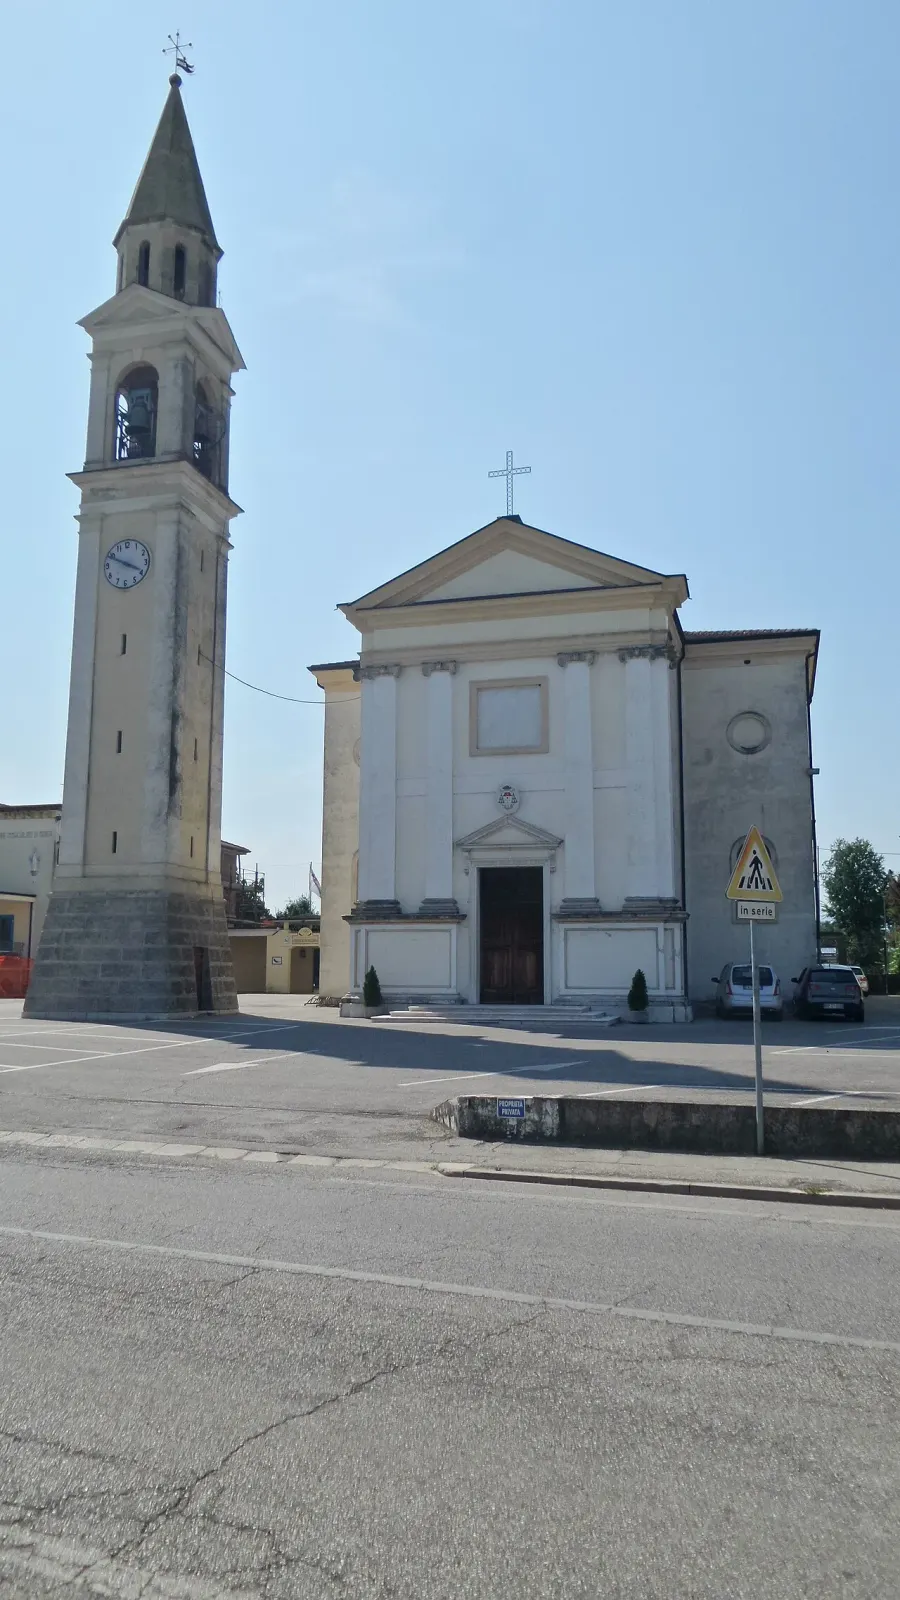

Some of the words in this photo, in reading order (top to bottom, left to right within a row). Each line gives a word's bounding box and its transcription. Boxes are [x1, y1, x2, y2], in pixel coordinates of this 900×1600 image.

[125, 541, 131, 549] 12
[144, 558, 148, 566] 3
[132, 576, 137, 584] 5
[740, 905, 749, 915] in
[751, 906, 773, 916] serie
[501, 1108, 521, 1116] PRIVATA
